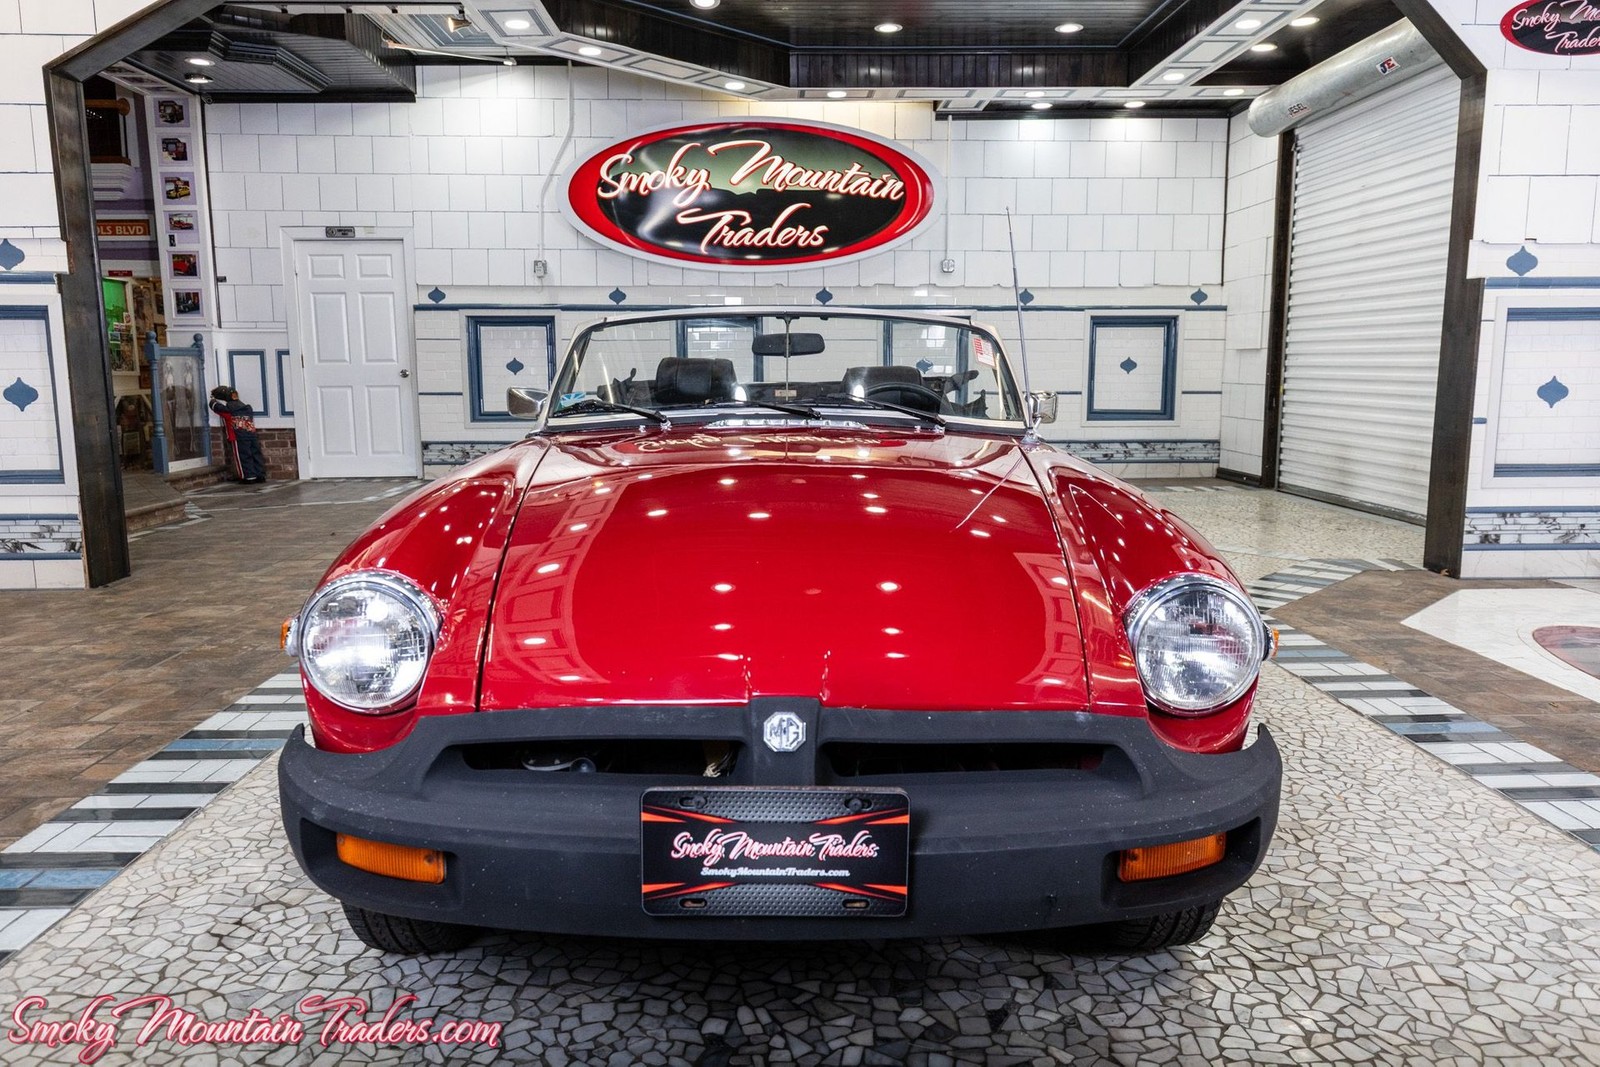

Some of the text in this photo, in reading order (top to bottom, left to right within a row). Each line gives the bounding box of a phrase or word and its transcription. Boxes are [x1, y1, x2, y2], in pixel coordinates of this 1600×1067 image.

[1511, 1, 1561, 32] Smoky
[597, 139, 905, 206] Smoky Mountain
[115, 225, 144, 235] BLVD
[676, 202, 829, 254] Traders
[769, 716, 801, 748] MG
[671, 828, 878, 866] Smoky Mountain Traders
[700, 866, 850, 878] SmokyMountainTraders.com
